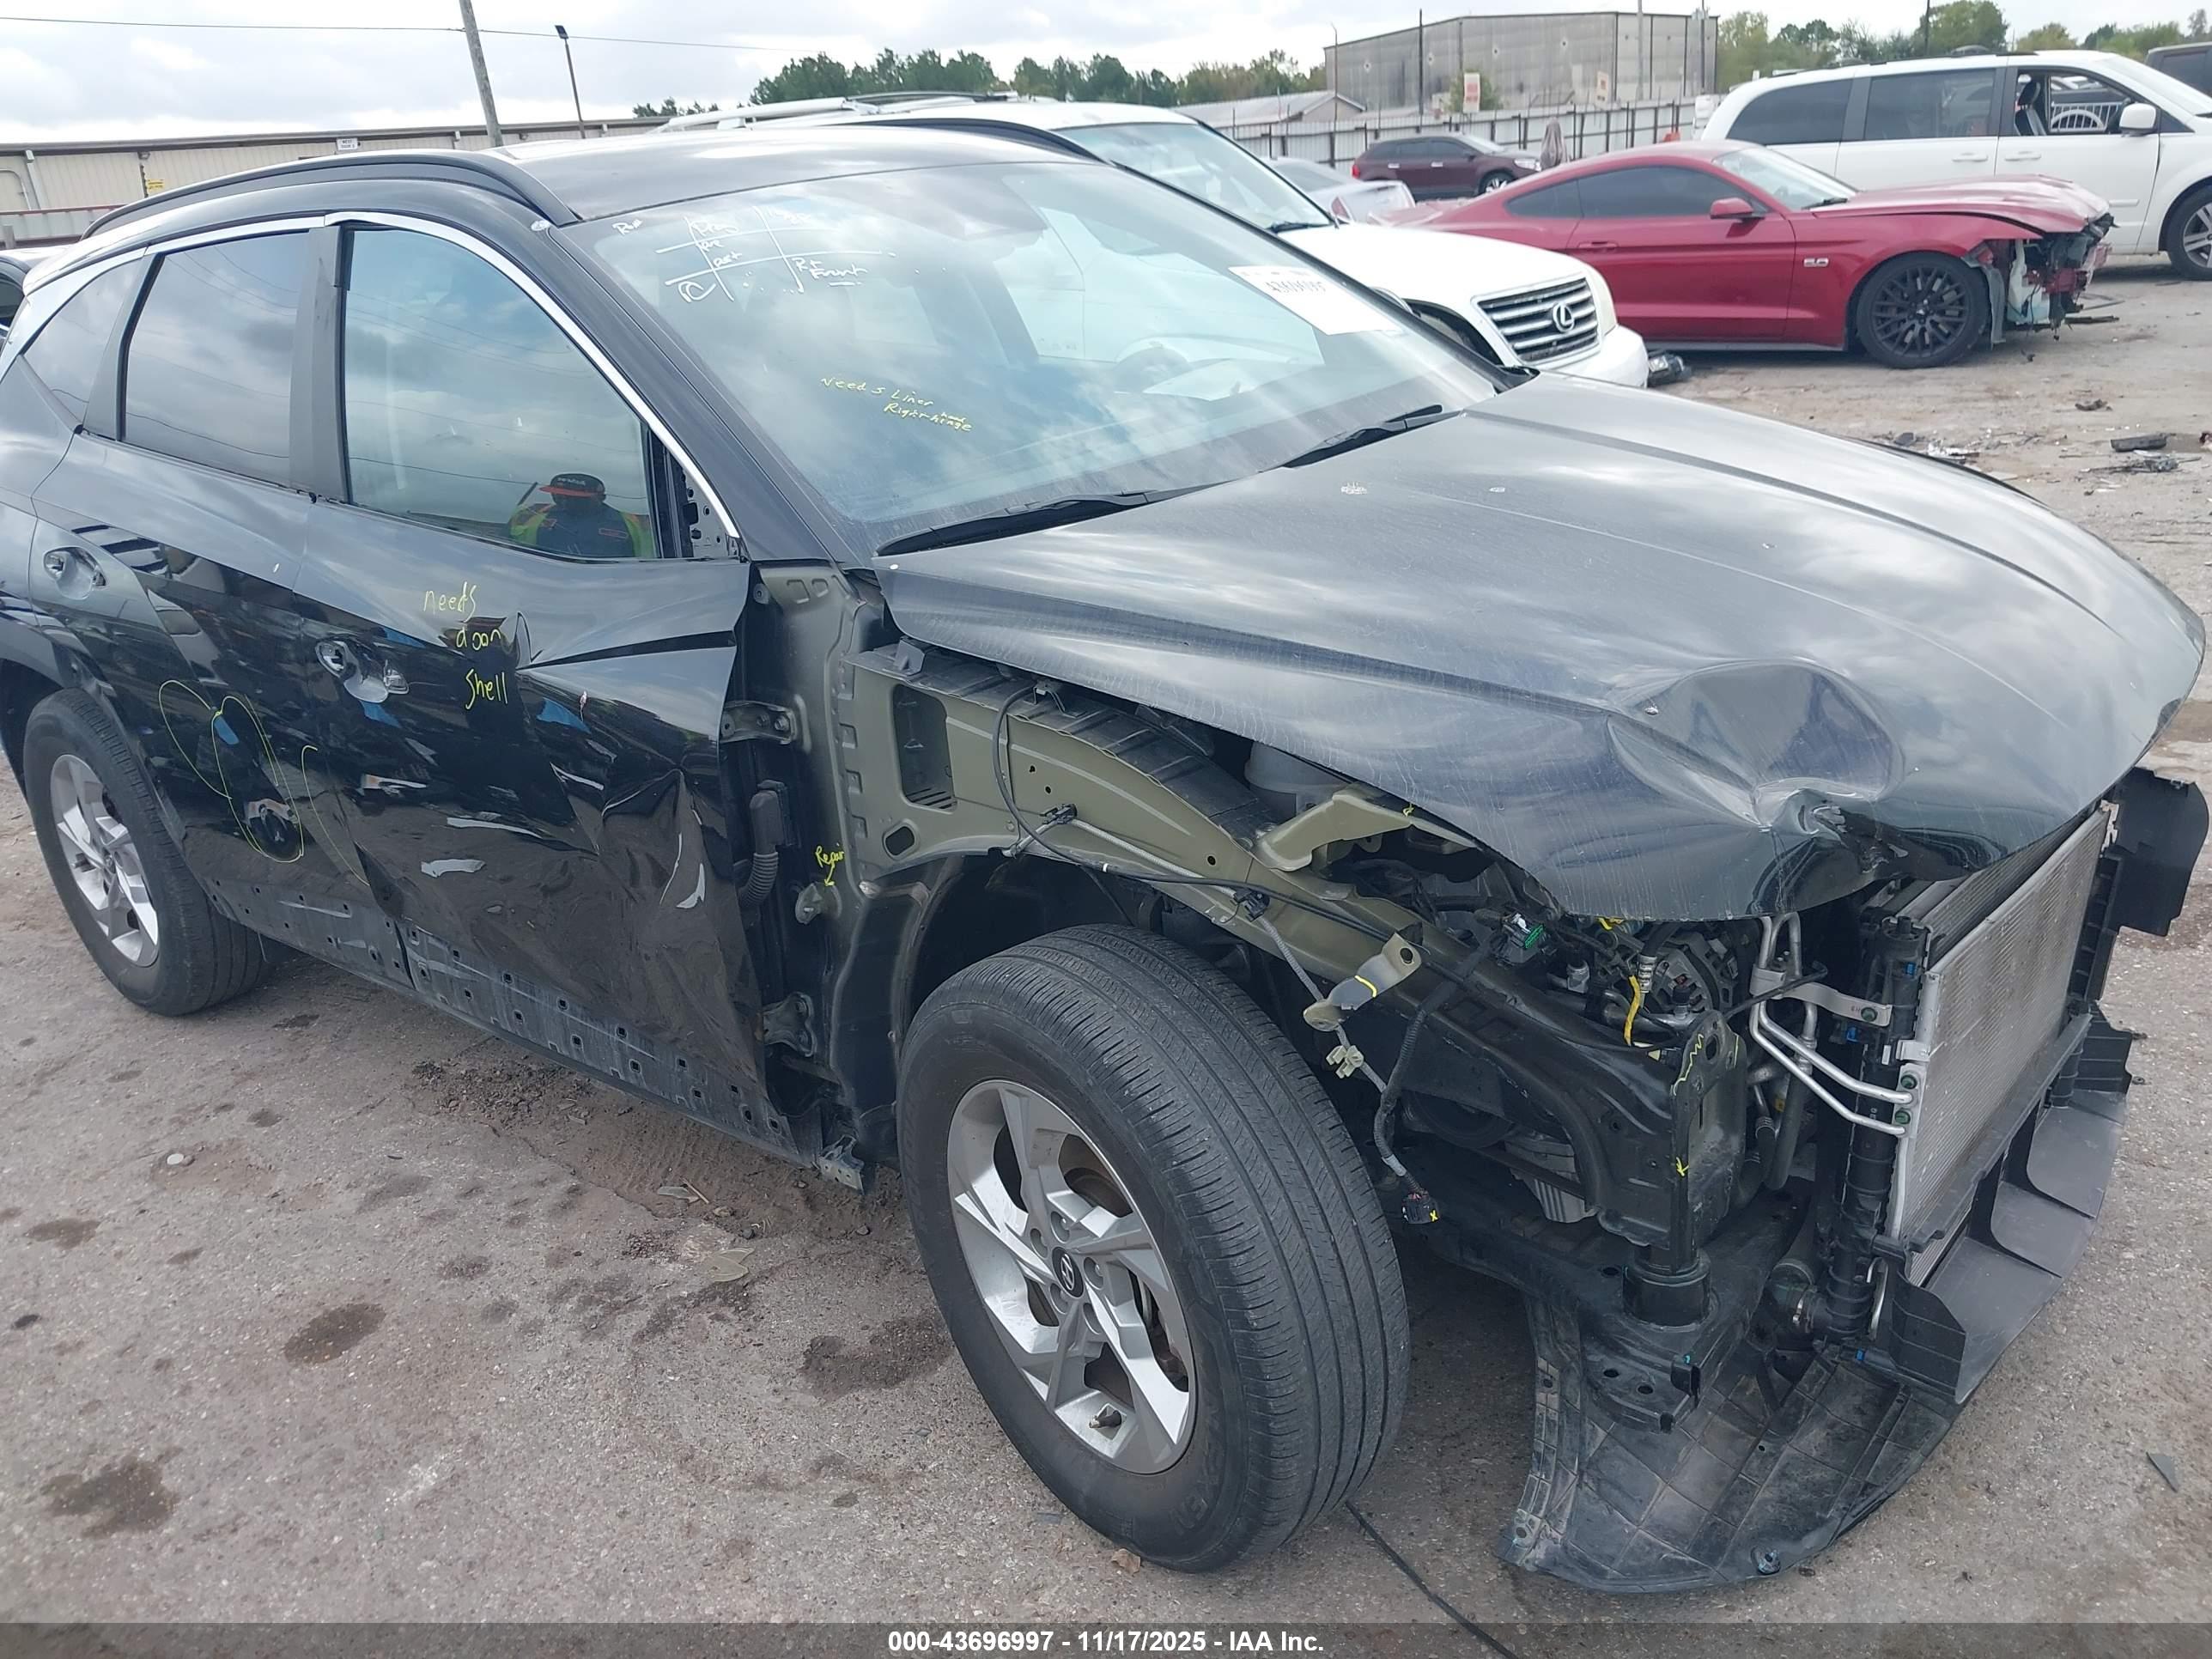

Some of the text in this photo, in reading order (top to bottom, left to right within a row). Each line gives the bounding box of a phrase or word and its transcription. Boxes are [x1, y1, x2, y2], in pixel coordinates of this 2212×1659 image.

[809, 263, 868, 280] Front
[423, 581, 477, 623] needs
[456, 628, 501, 650] door
